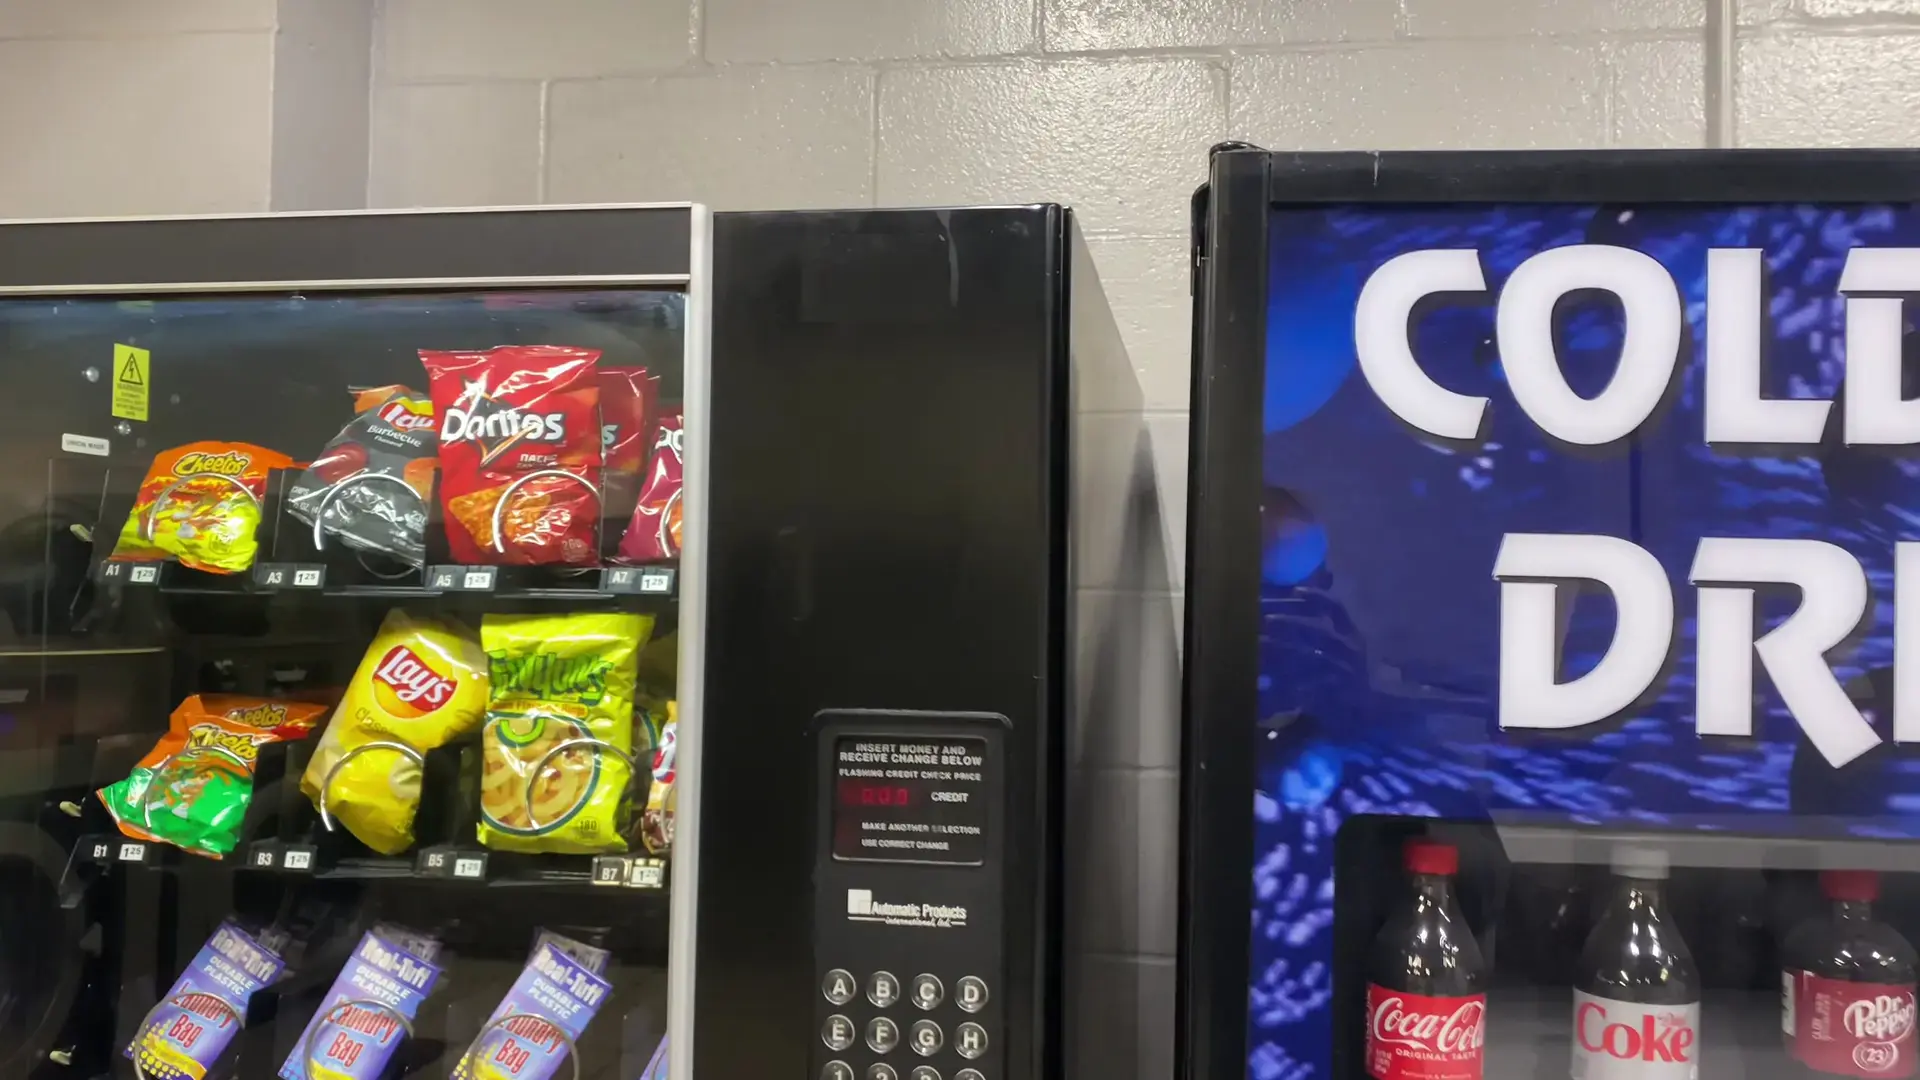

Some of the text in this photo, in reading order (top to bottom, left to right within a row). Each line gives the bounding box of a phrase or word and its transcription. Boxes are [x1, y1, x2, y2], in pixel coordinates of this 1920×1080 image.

[440, 408, 564, 442] Doritos
[367, 424, 422, 448] Barbecue
[173, 451, 249, 476] Cheetos
[105, 565, 120, 577] A1
[266, 572, 283, 584] A3
[436, 573, 452, 586] A5
[612, 571, 628, 584] A7
[377, 647, 454, 703] Lay's
[839, 751, 982, 766] RECEIVE CHANGE BELOW
[855, 743, 966, 756] INSERT MONEY AND
[839, 768, 982, 781] FLASHING CREDIT CHECK PRICE
[930, 791, 969, 803] CREDIT
[861, 822, 887, 831] MAKE
[888, 823, 929, 832] ANOTHER
[93, 845, 108, 857] B1
[861, 838, 950, 851] USE CORRECT CHANGE
[258, 853, 272, 866] B3
[428, 853, 444, 867] B5
[601, 868, 618, 881] B7
[871, 902, 968, 920] Automatic Products
[203, 964, 245, 995] PLASTIC
[209, 955, 254, 990] DURABLE
[351, 975, 402, 1006] PLASTIC
[355, 965, 411, 1000] DURABLE
[832, 978, 848, 996] A
[876, 980, 891, 998] B
[919, 982, 936, 1001] C
[532, 977, 581, 1014] DURABLE
[963, 984, 980, 1003] D
[527, 987, 572, 1020] PLASTIC
[1875, 994, 1903, 1018] Dr
[1853, 999, 1914, 1040] Pepper
[168, 1014, 204, 1049] Bag
[831, 1022, 846, 1042] E
[875, 1025, 889, 1044] F
[918, 1028, 935, 1047] G
[963, 1030, 979, 1050] H
[1576, 1001, 1695, 1063] Coke
[326, 1031, 364, 1068] Bag
[494, 1037, 531, 1074] Bag
[1395, 1047, 1449, 1062] ORIGINAL
[1866, 1047, 1885, 1062] 23
